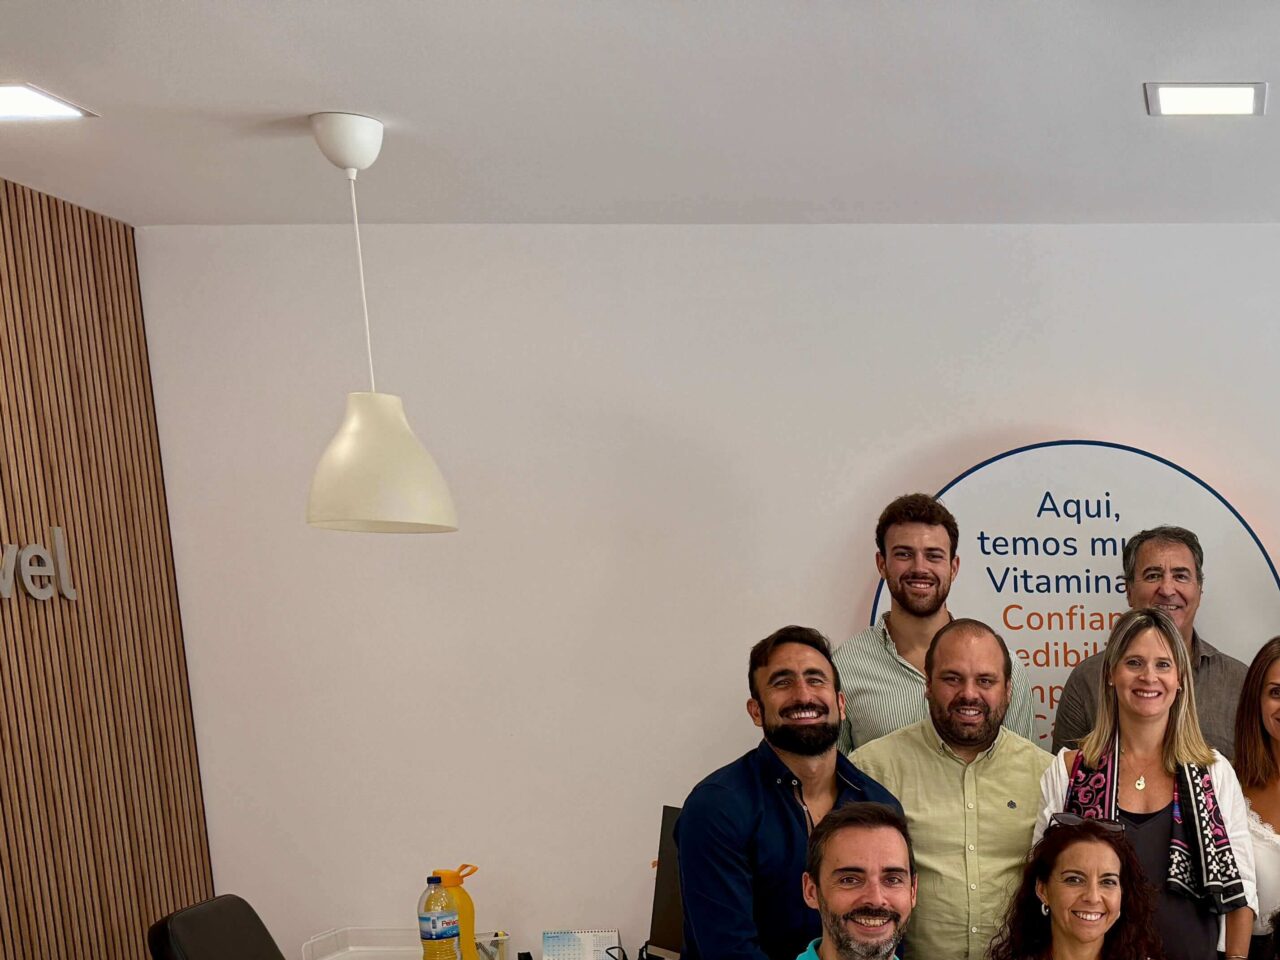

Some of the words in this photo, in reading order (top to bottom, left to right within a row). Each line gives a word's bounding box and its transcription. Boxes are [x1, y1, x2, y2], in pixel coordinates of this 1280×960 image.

[1036, 490, 1121, 525] Aqui,
[976, 530, 1079, 556] temos
[1015, 641, 1108, 668] edibil
